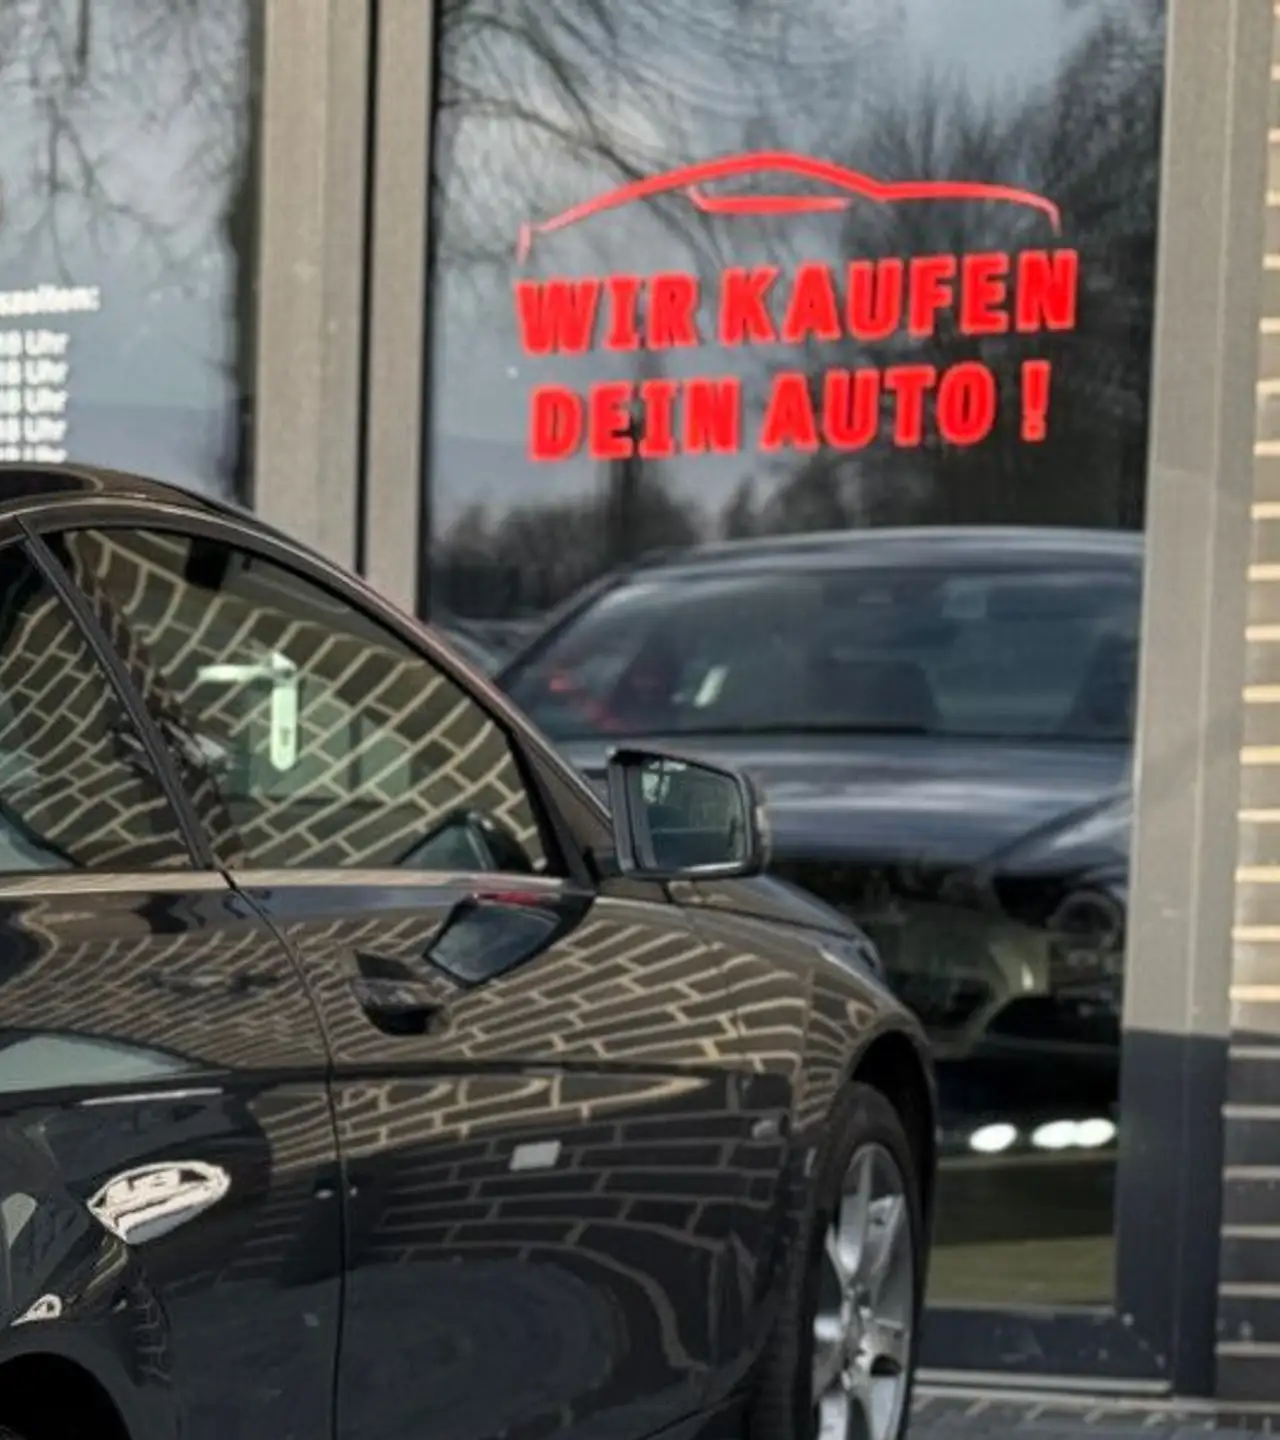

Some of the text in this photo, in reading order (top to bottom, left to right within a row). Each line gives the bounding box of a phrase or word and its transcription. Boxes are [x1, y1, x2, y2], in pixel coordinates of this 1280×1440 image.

[515, 249, 1080, 356] WIR KAUFEN
[529, 377, 740, 461] DEIN
[759, 361, 997, 451] AUTO
